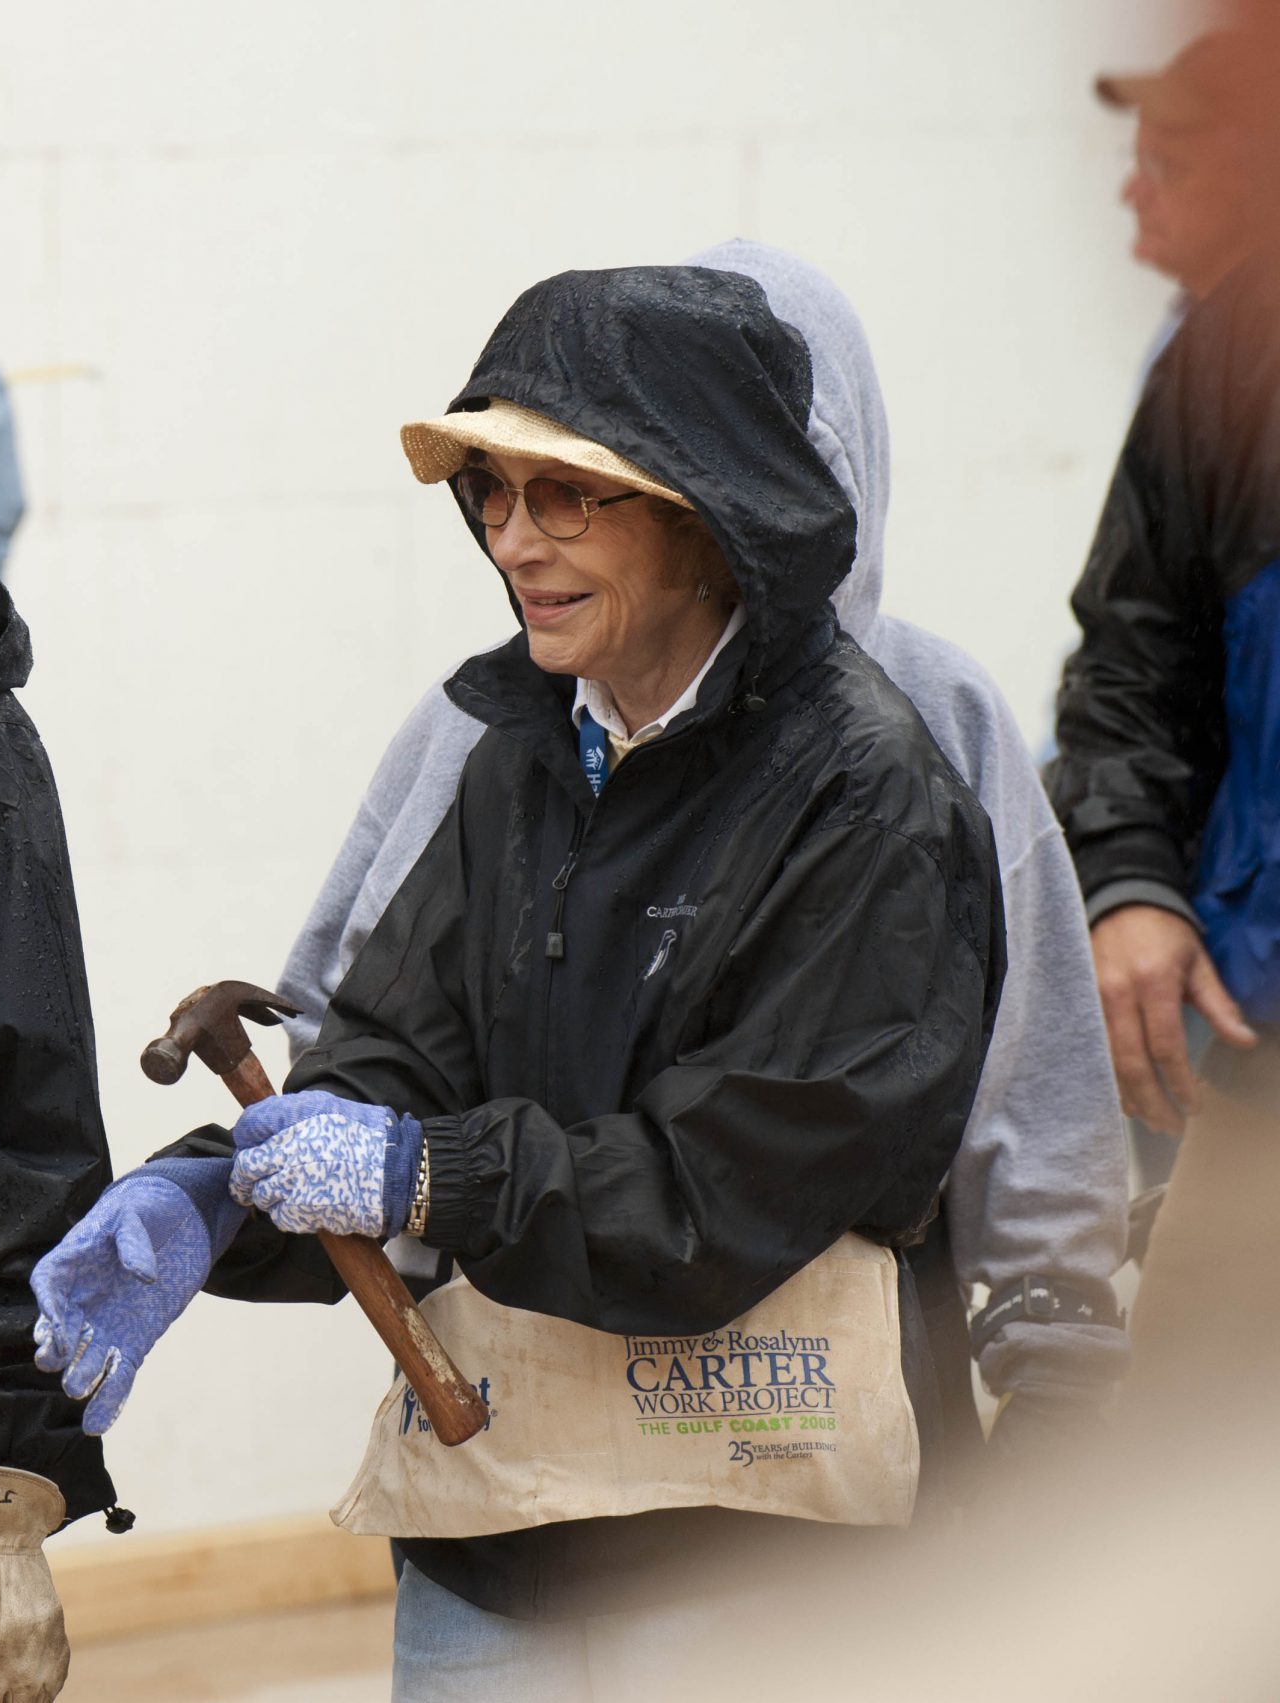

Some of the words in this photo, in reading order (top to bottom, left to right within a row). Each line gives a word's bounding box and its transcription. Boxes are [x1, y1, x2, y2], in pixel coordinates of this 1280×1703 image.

[624, 1335, 697, 1361] Jimmy
[702, 1332, 724, 1352] &
[728, 1330, 831, 1357] Rosalynn
[626, 1352, 835, 1392] CARTER
[632, 1391, 717, 1415] WORK
[721, 1387, 837, 1414] PROJECT
[638, 1421, 671, 1436] THE
[676, 1419, 723, 1435] GULF
[729, 1417, 793, 1433] COAST
[799, 1416, 837, 1431] 2008
[728, 1440, 754, 1468] 25
[751, 1444, 782, 1453] YEARS
[782, 1444, 791, 1452] of
[792, 1442, 836, 1452] BUILDING
[756, 1452, 772, 1460] with
[773, 1451, 785, 1460] the
[786, 1451, 813, 1460] Carters
